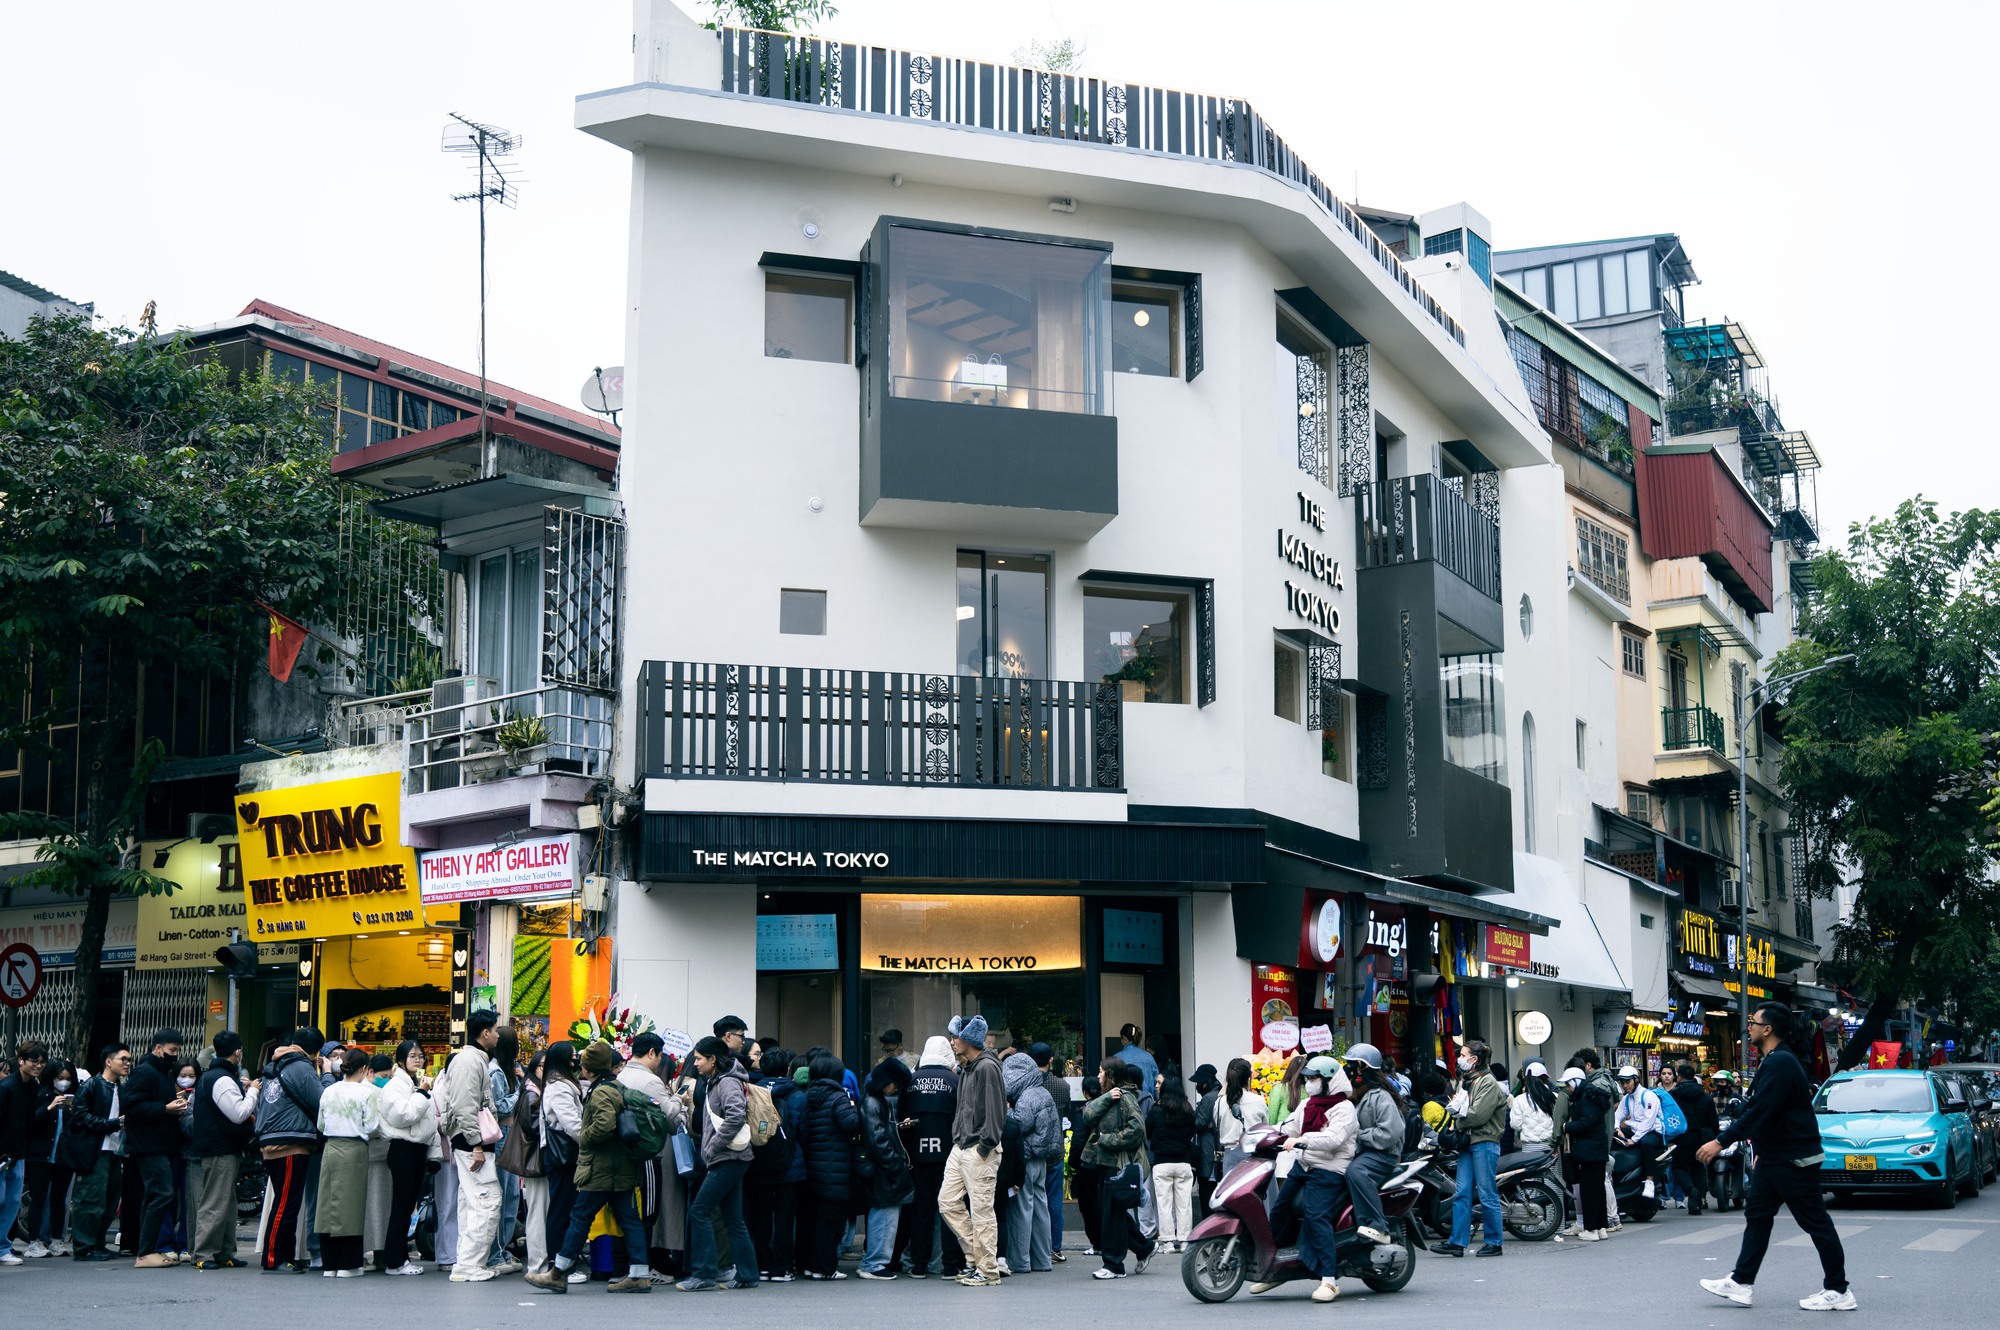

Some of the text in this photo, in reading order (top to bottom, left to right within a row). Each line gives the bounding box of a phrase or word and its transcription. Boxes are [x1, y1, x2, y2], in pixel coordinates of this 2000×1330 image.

[1297, 492, 1326, 532] THE
[1278, 528, 1344, 591] MATCHA
[1285, 580, 1341, 634] TOKYO
[258, 803, 382, 858] TRUNG
[423, 842, 570, 880] THIEN Y ART GALLERY
[734, 851, 817, 867] MATCHA
[823, 852, 889, 868] TOKYO
[249, 864, 406, 905] THE COFFEE HOUSE
[431, 870, 562, 891] Hand Carry Shipping Abroad Order Your Own
[33, 912, 54, 920] HIỆU
[57, 911, 77, 919] MAY
[170, 903, 246, 920] TAILOR MAD
[366, 910, 413, 924] 033 478 2290
[158, 930, 182, 941] Linen
[189, 928, 220, 940] Cotton
[266, 923, 274, 933] 38
[296, 920, 306, 931] GAI
[0, 926, 34, 949] KIM
[40, 922, 84, 949] THA
[140, 954, 148, 963] 40
[149, 954, 167, 964] Hang
[170, 953, 182, 961] Gai
[184, 951, 207, 961] Street
[905, 957, 973, 970] MATCHA
[979, 956, 1037, 970] TOKYO
[1258, 969, 1294, 983] KingRoti
[1633, 1024, 1655, 1044] ROTI
[916, 1077, 944, 1085] YOUTH
[919, 1137, 941, 1153] FR
